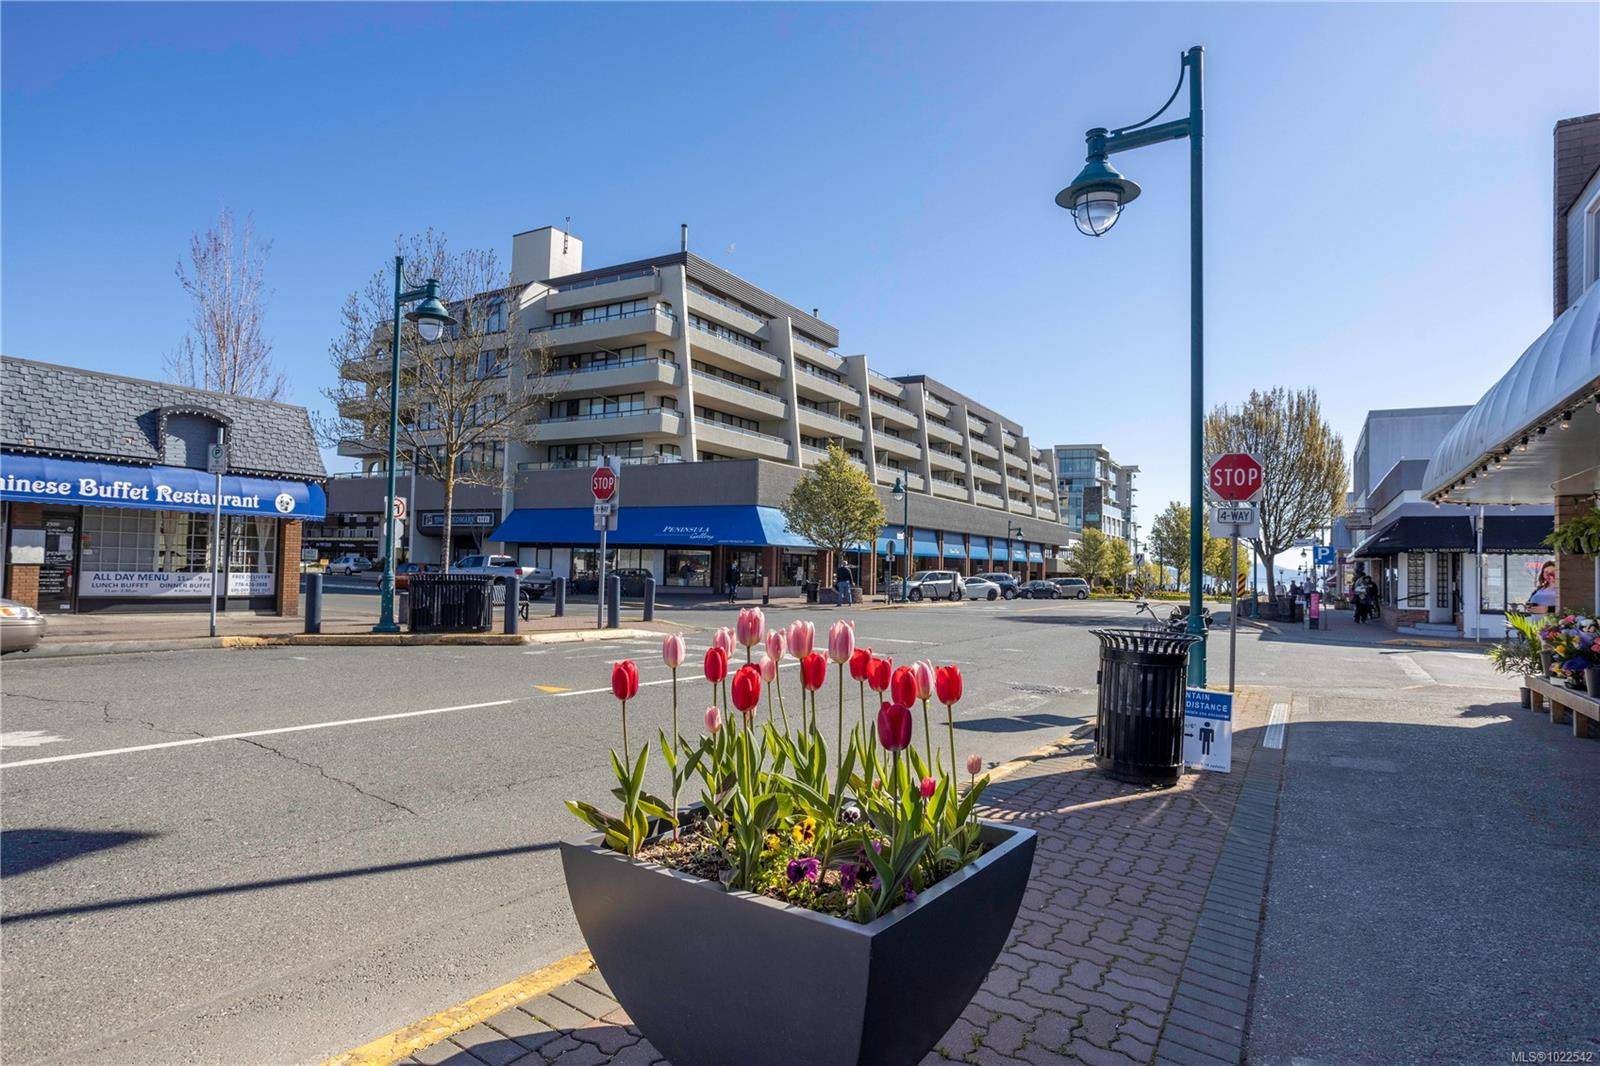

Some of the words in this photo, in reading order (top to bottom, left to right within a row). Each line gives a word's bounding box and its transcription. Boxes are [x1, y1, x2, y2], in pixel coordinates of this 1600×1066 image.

[593, 477, 614, 490] STOP
[1213, 468, 1258, 487] STOP
[78, 478, 149, 500] Buffet
[156, 485, 260, 508] Restaurant
[1220, 511, 1250, 521] 4-WAY
[1317, 547, 1330, 559] P
[93, 573, 112, 581] ALL
[114, 573, 135, 581] DAY
[137, 573, 169, 582] MENU
[1186, 701, 1228, 713] DISTANCE
